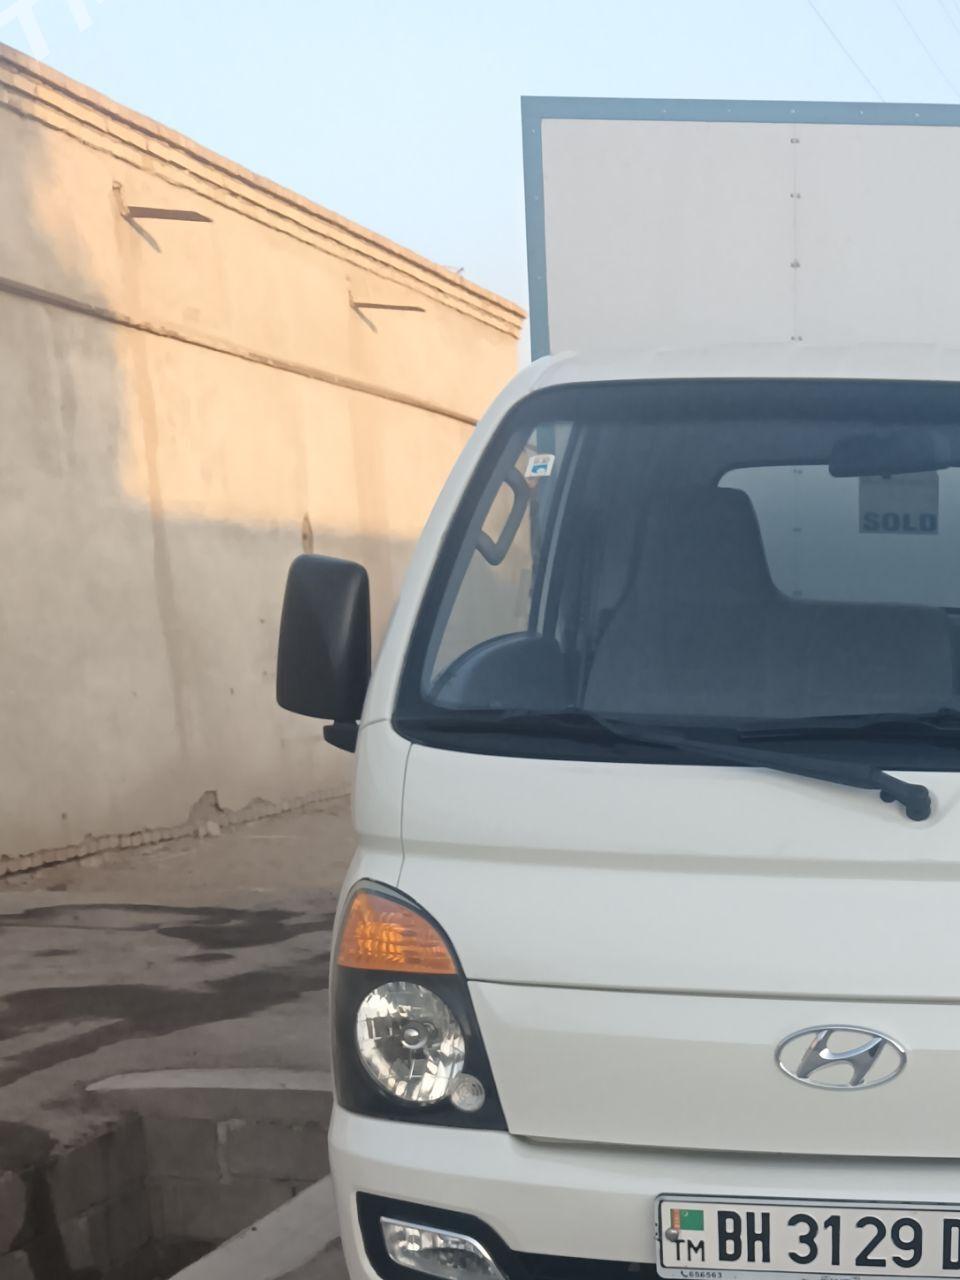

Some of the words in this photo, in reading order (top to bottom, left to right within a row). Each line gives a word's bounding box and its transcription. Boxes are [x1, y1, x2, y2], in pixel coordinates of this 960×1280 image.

[862, 512, 938, 532] SOLD
[671, 1239, 705, 1262] TM
[717, 1210, 771, 1263] BH
[787, 1213, 923, 1268] 3129
